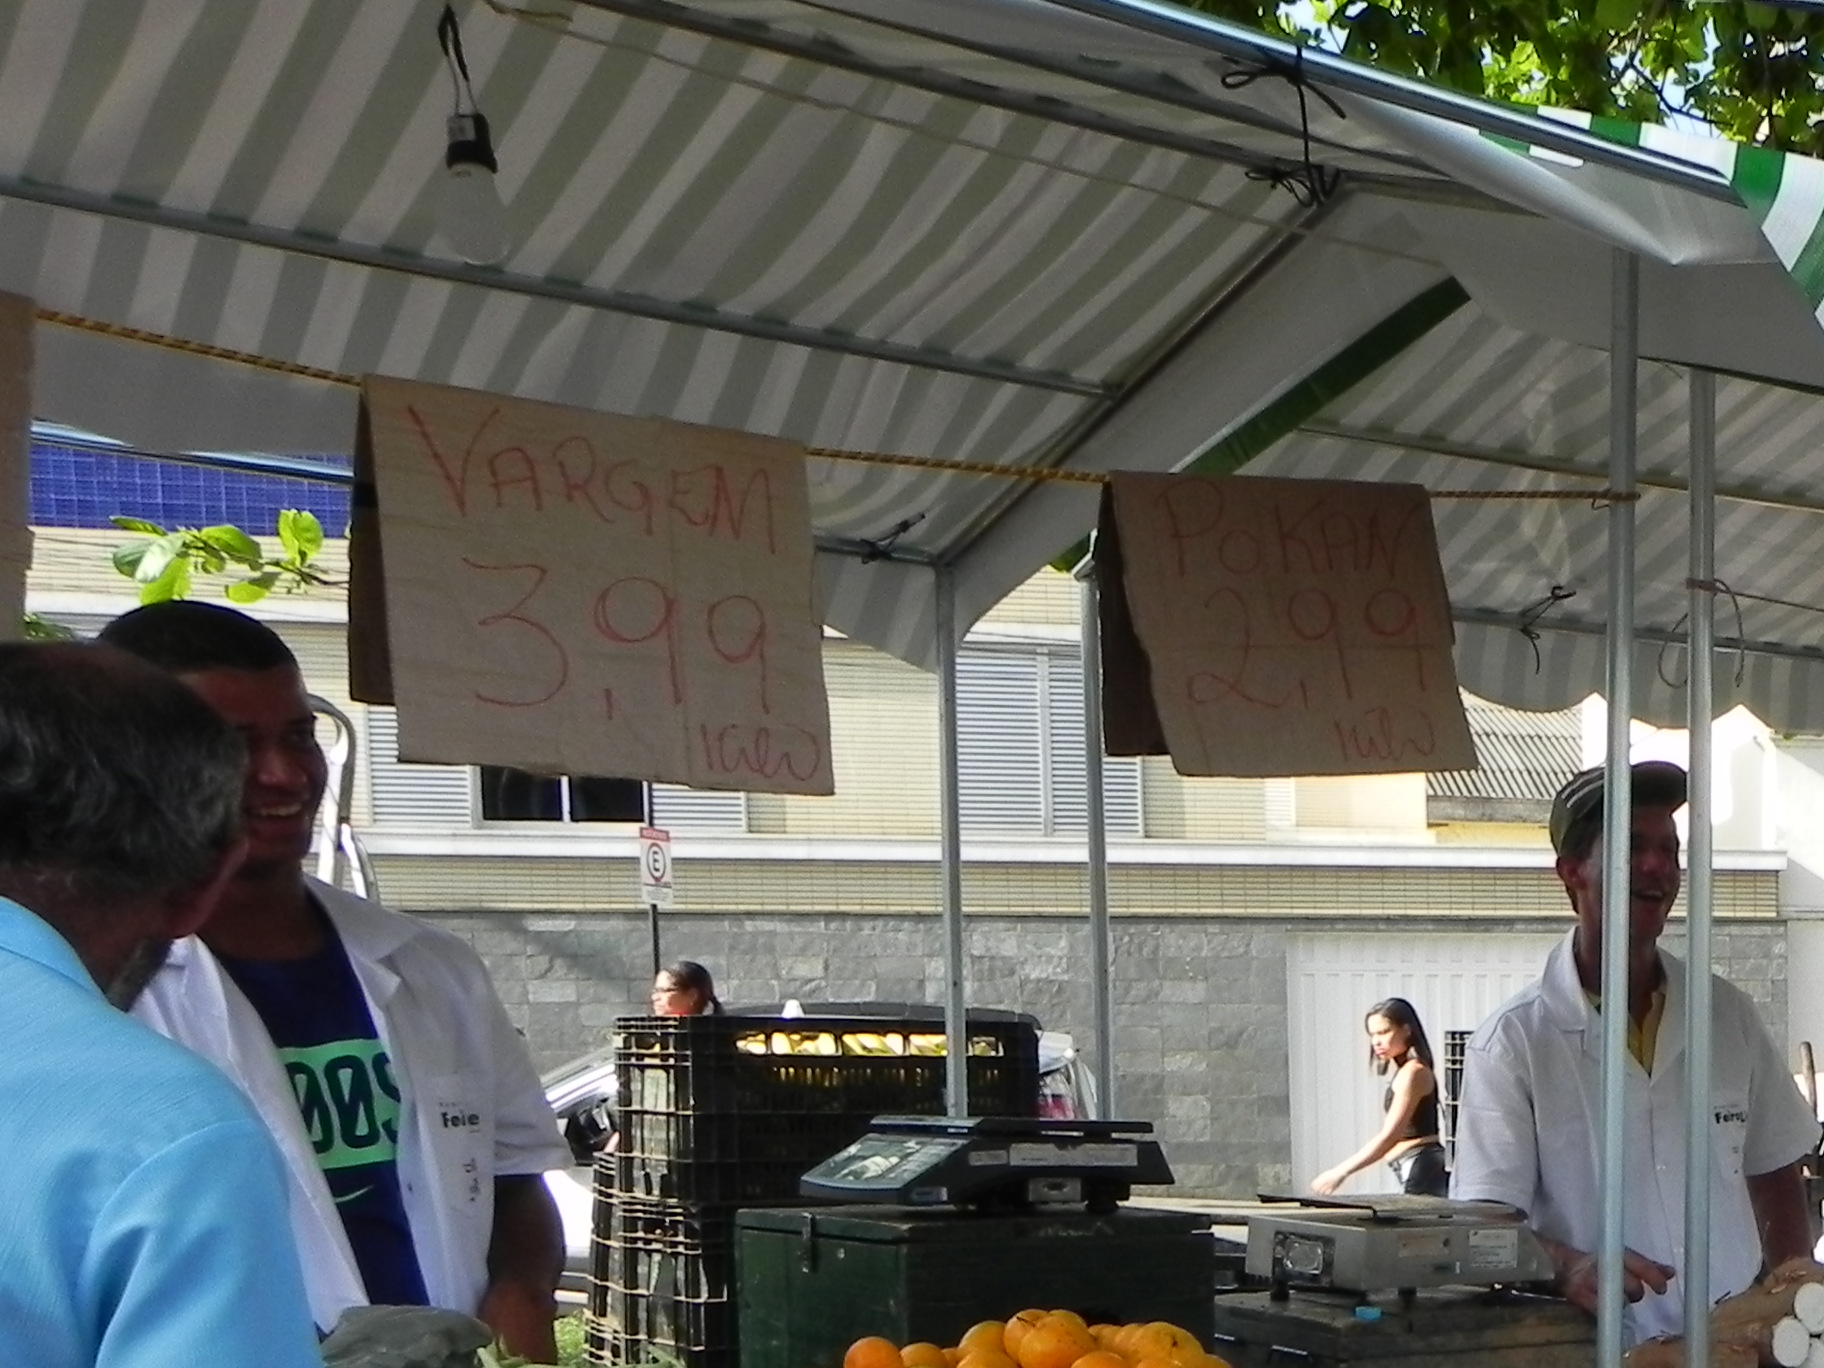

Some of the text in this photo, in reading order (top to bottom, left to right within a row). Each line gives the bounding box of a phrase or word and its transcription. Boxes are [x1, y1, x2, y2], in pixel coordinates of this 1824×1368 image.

[406, 404, 776, 555] VARGEM
[460, 556, 771, 721] 3,99
[1186, 587, 1427, 710] 2,99
[652, 850, 660, 873] E
